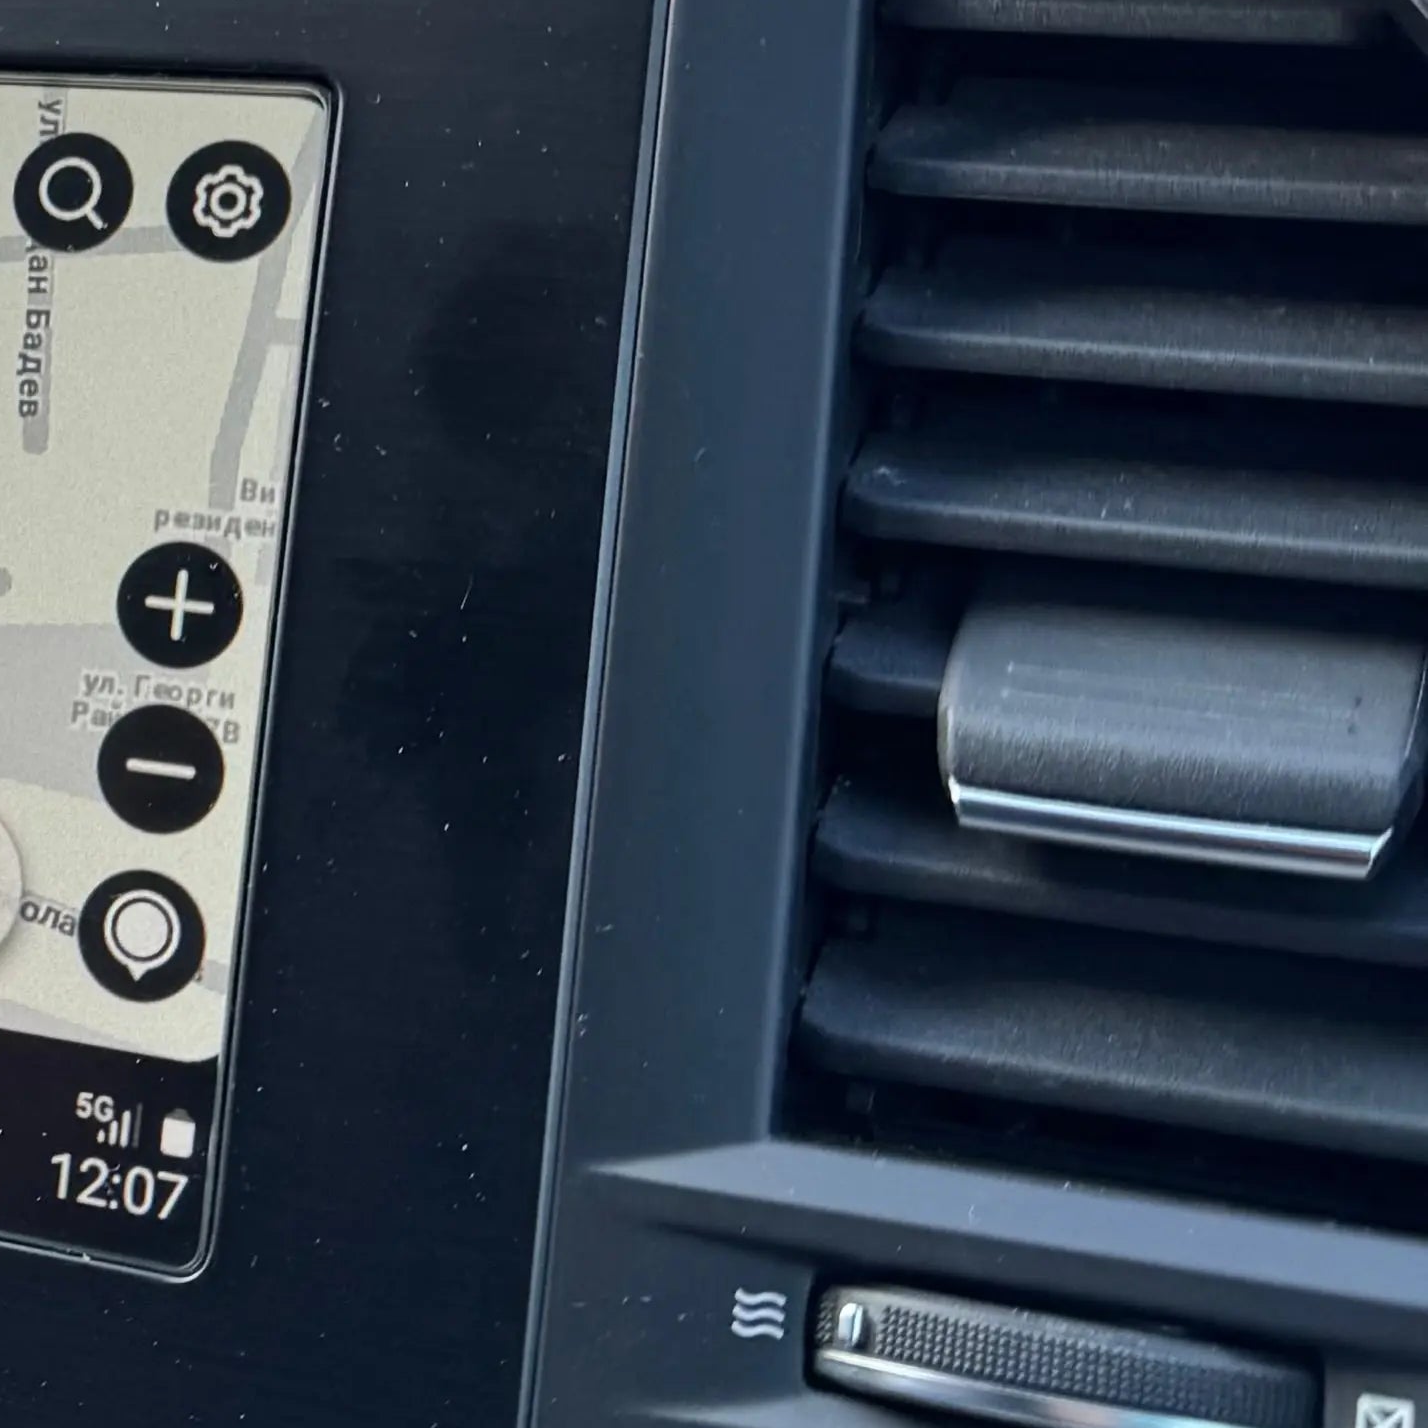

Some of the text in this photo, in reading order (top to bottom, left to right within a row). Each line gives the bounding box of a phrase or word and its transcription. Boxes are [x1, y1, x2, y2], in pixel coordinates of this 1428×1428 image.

[16, 309, 51, 418] Бадев
[83, 674, 235, 709] ул. Георги
[75, 1091, 115, 1122] 5G
[51, 1153, 189, 1220] 12:07
